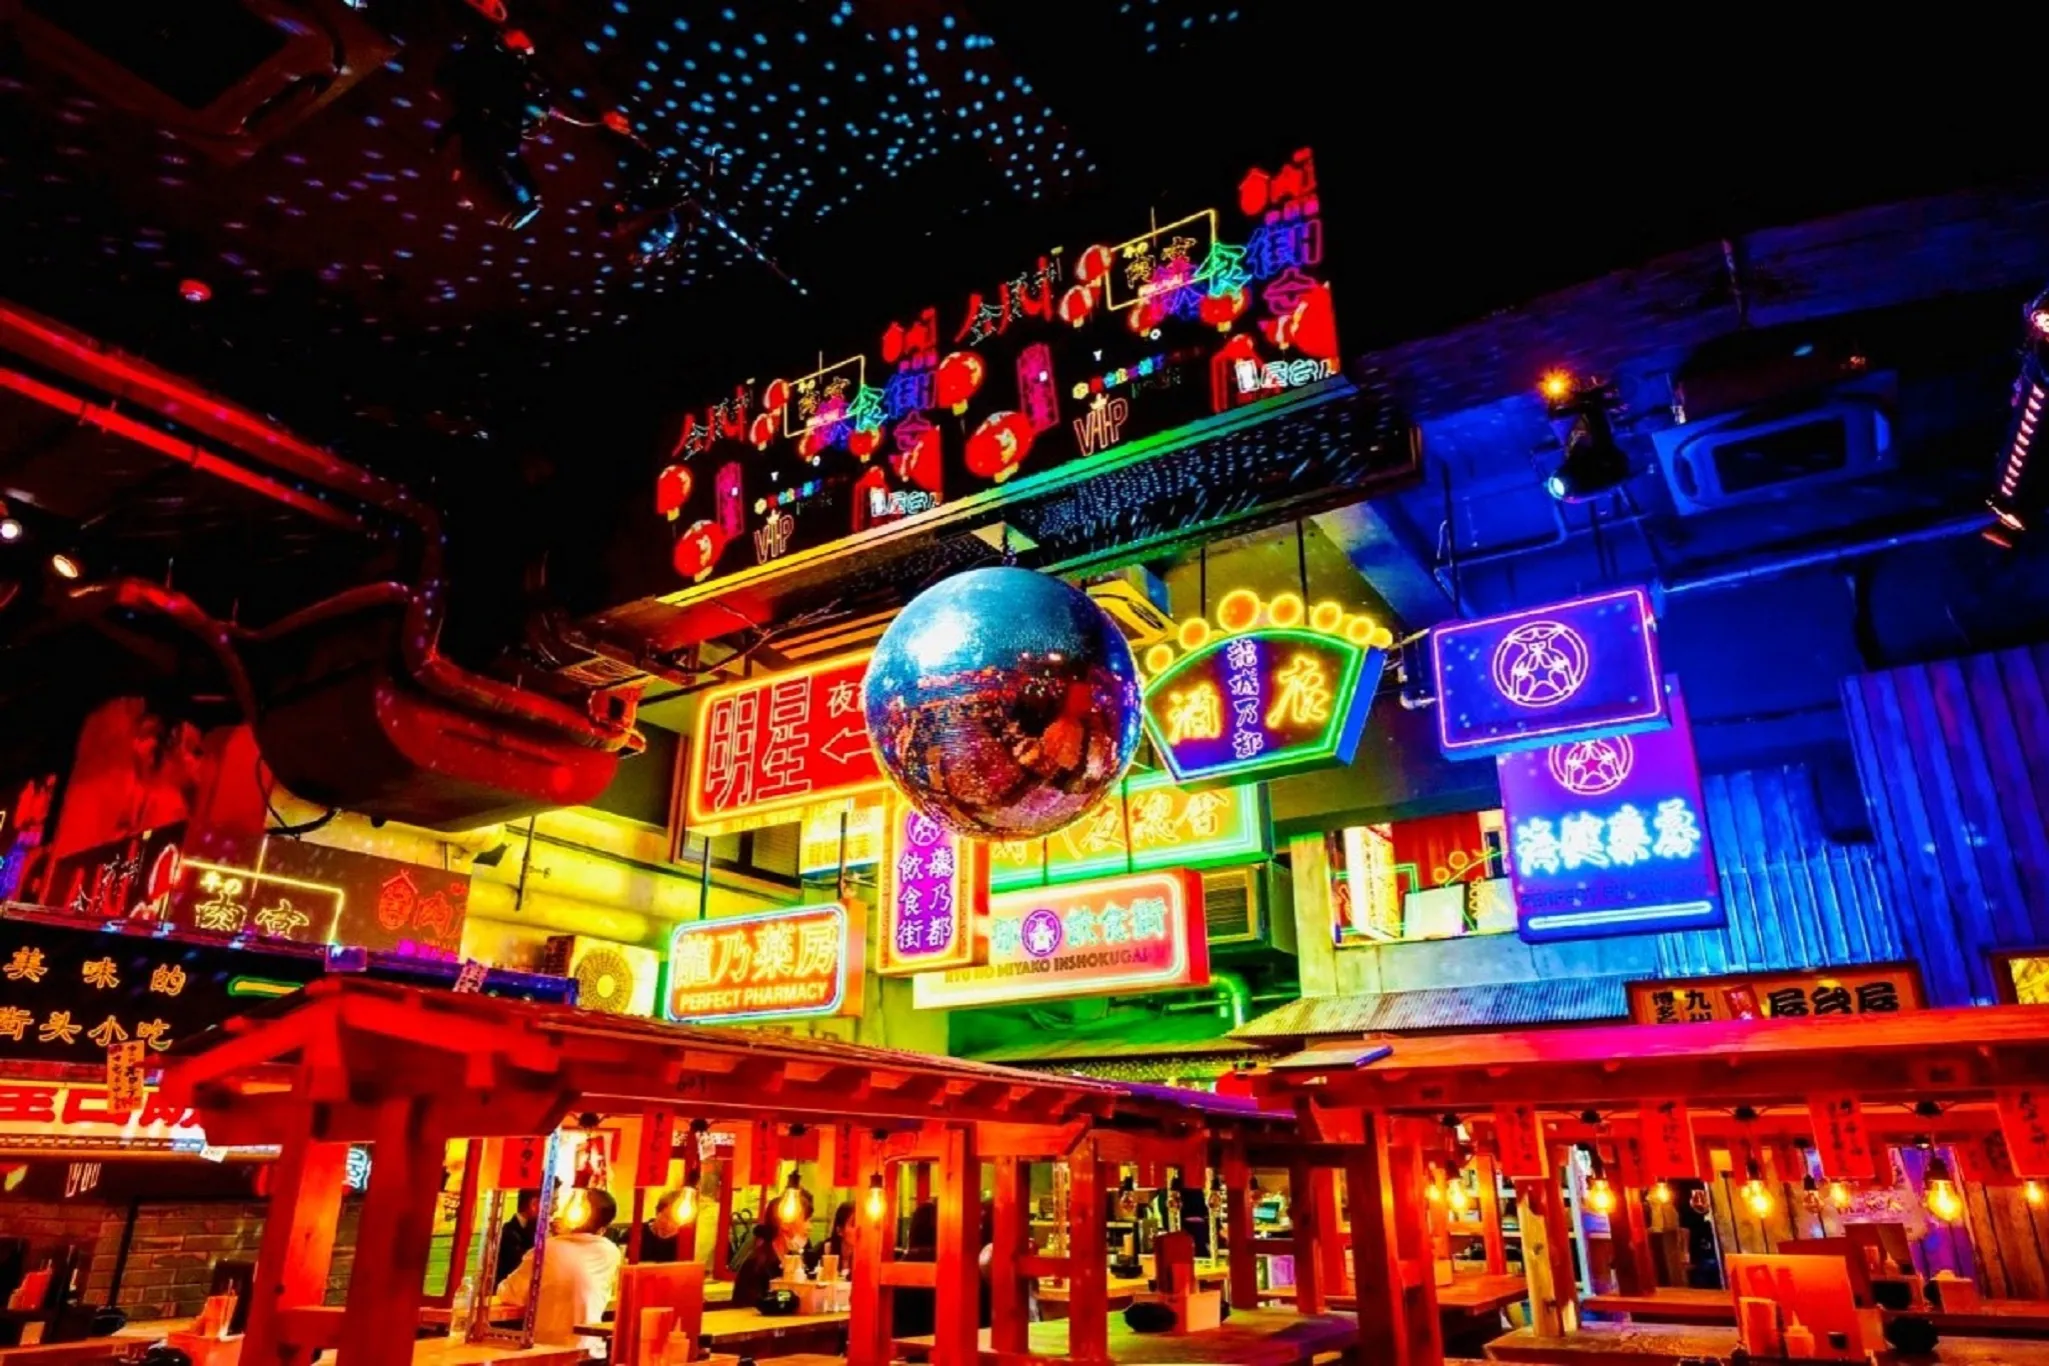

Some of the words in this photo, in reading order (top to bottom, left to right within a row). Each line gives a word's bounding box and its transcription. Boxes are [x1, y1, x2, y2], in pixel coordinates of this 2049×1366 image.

[1073, 398, 1128, 457] VIP
[754, 515, 794, 564] VIP
[897, 851, 924, 949] 飲食街
[3, 945, 187, 996] 美味的
[997, 959, 1051, 978] MIYAKO
[1053, 947, 1149, 974] INSHOKUGAI
[680, 988, 741, 1012] PERFECT
[743, 982, 828, 1007] PHARMACY
